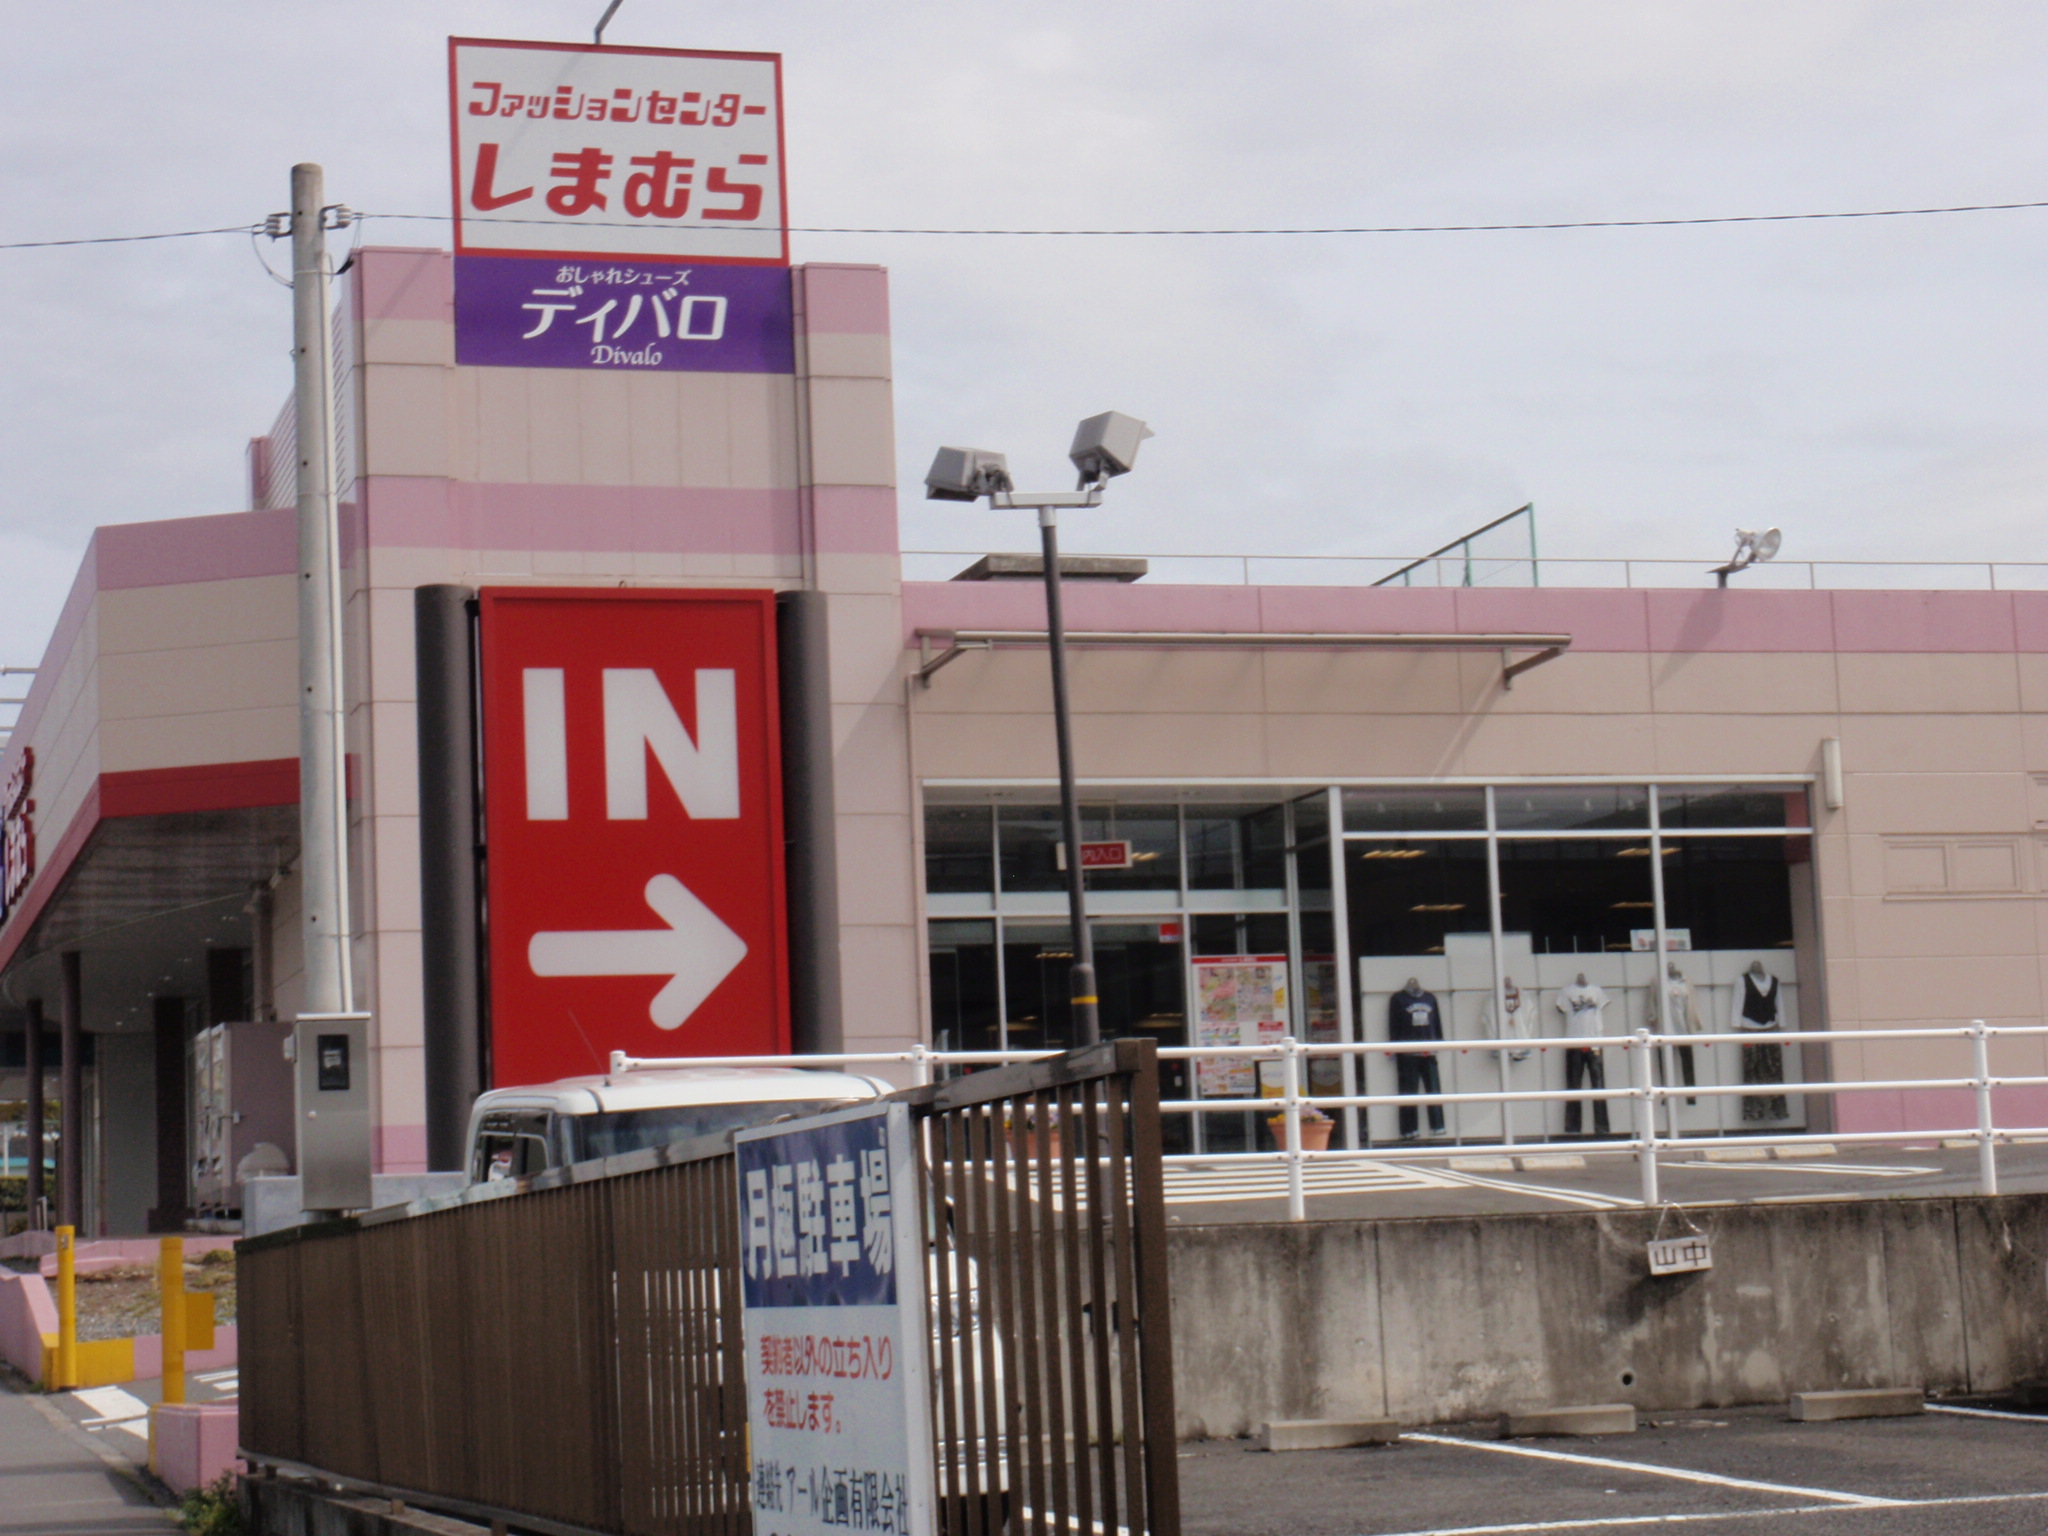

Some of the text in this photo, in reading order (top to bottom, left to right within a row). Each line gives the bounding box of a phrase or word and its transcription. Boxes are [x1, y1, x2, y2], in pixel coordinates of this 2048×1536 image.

[468, 81, 767, 127] ファッションセンター
[470, 142, 769, 221] しまむら
[555, 265, 692, 287] おしゃれシューズ
[521, 284, 728, 344] ディバロ
[590, 343, 663, 366] Divalo
[522, 667, 741, 821] IN
[746, 1149, 892, 1281] 月極駐車場
[1655, 1241, 1707, 1266] 山中
[761, 1334, 893, 1380] 契約者以外の立ち入り
[764, 1387, 842, 1434] を禁止します。
